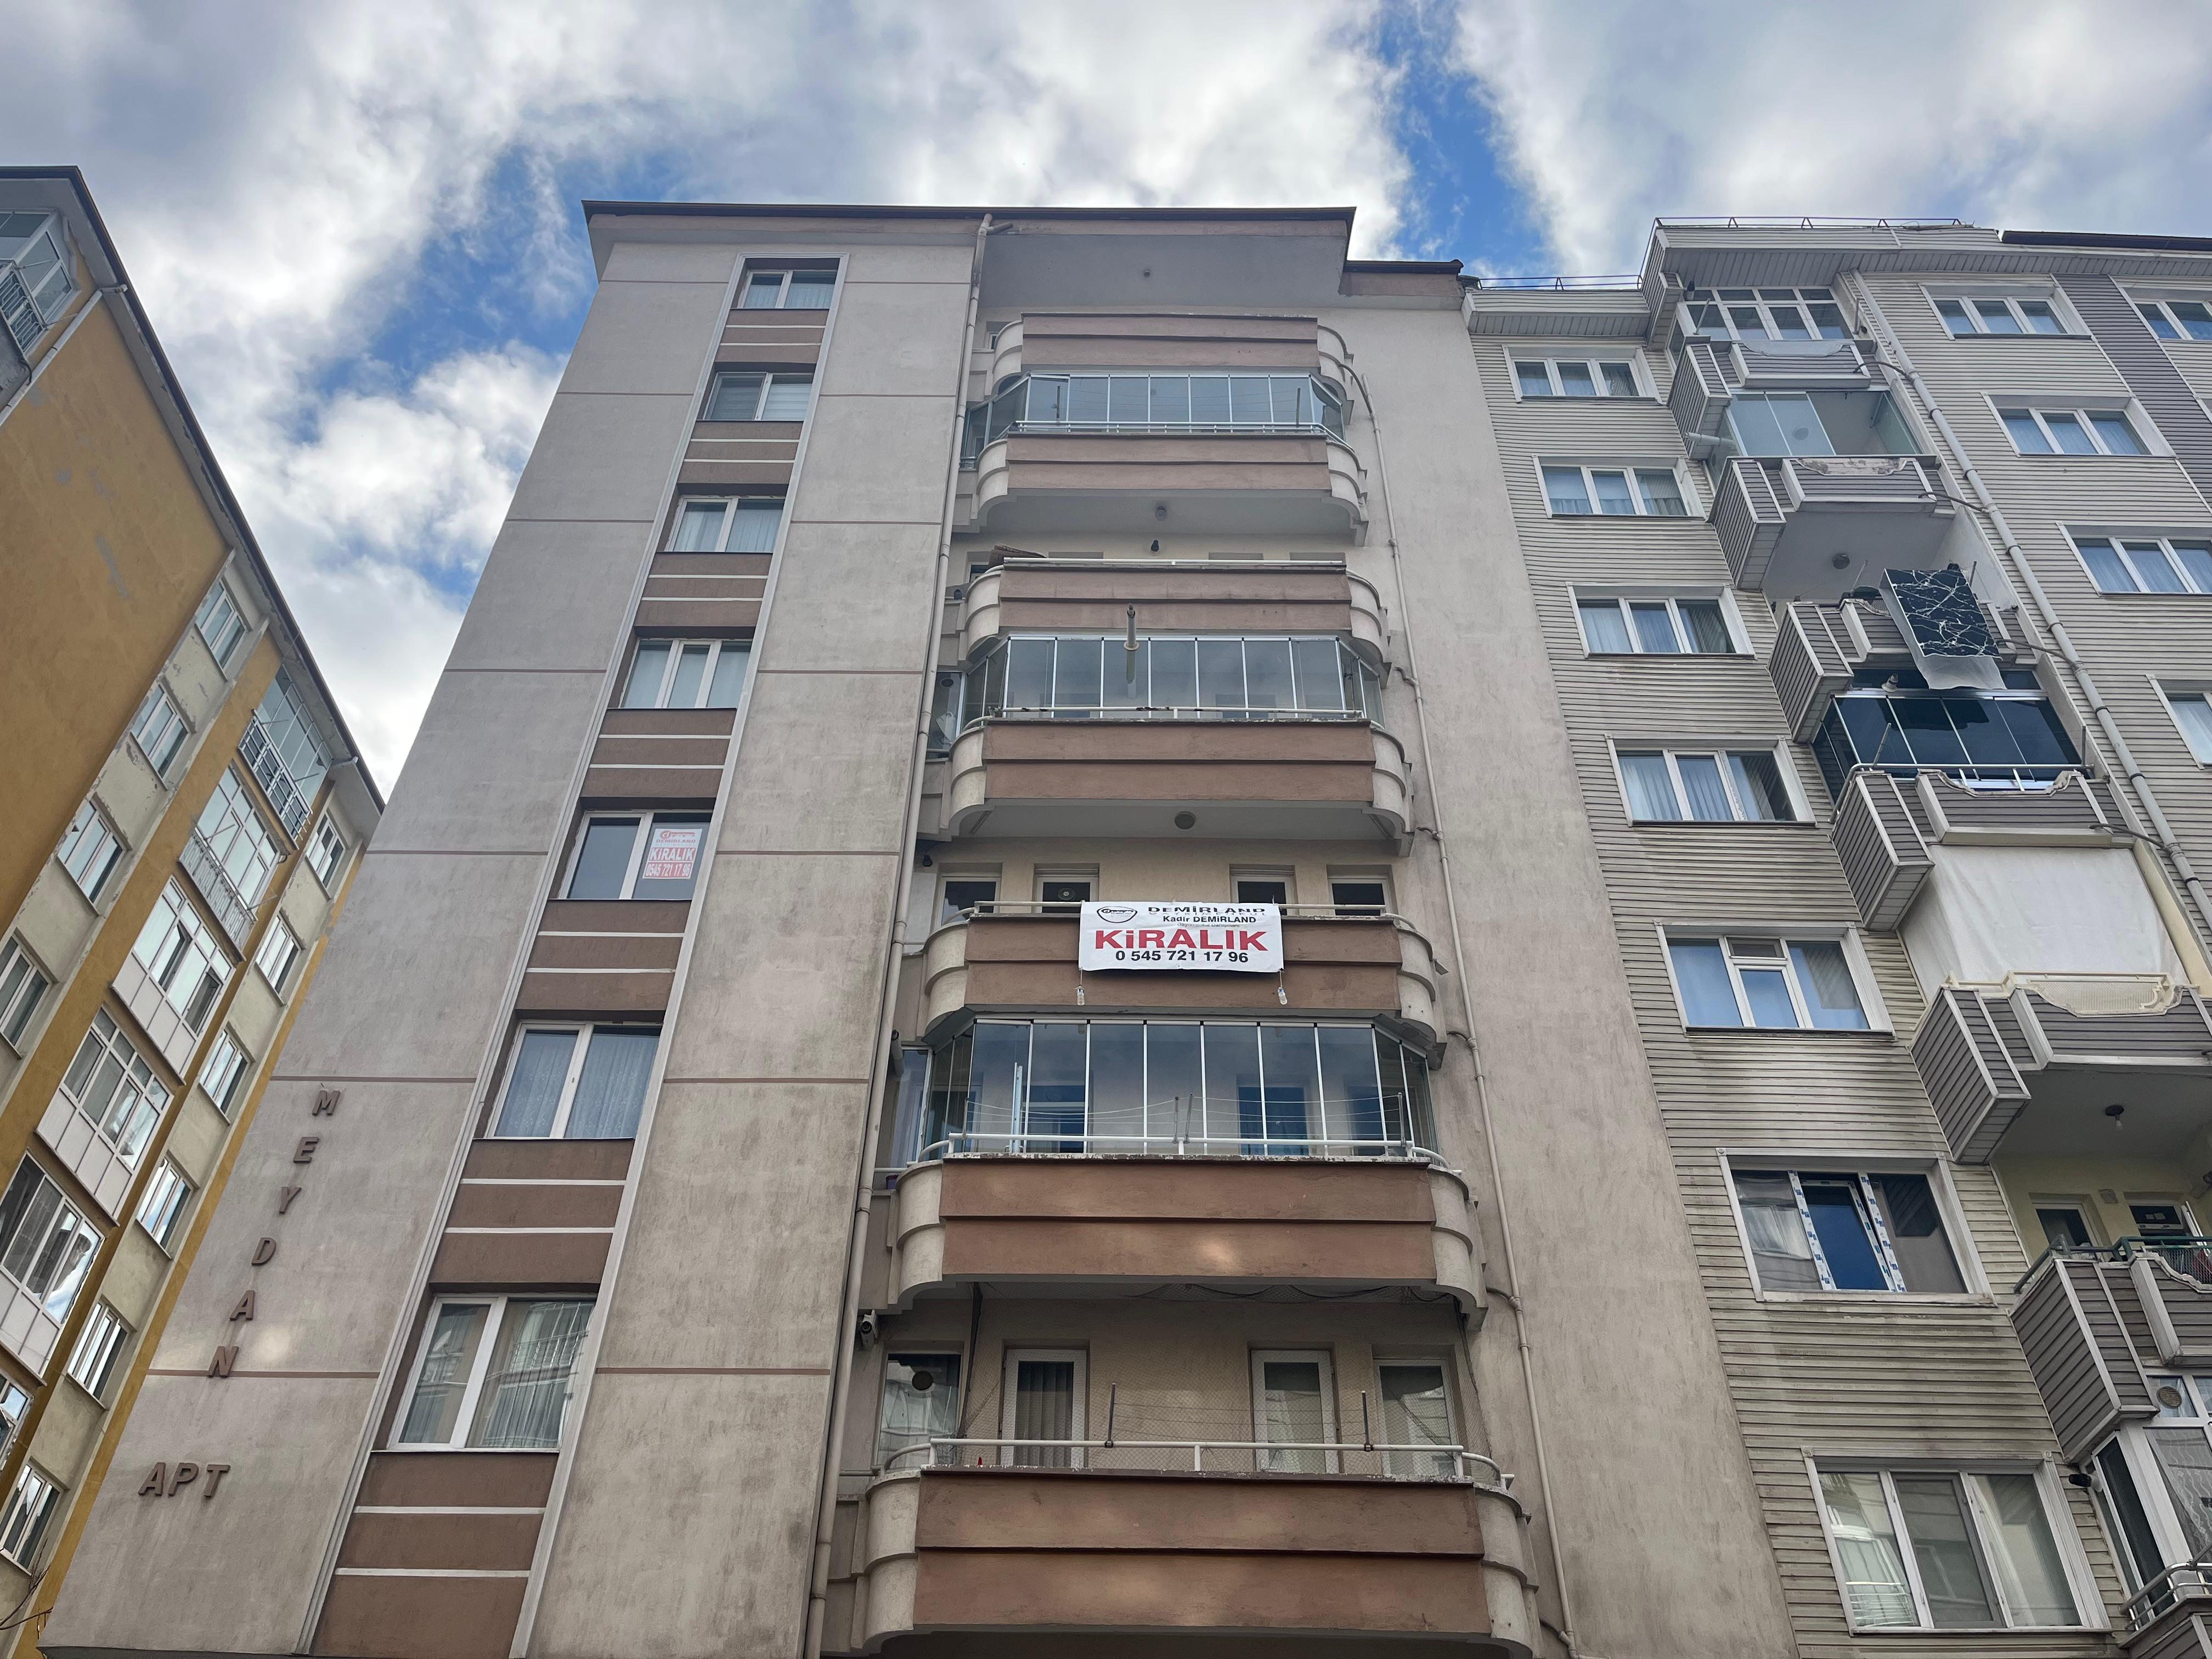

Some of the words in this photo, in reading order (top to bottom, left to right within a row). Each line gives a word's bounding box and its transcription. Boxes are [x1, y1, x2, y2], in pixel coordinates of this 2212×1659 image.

[646, 864, 662, 877] 0545
[661, 864, 674, 877] 721
[674, 864, 682, 877] 17
[1115, 951, 1125, 961] 0
[1131, 951, 1161, 961] 545
[1166, 950, 1195, 961] 721
[1204, 952, 1222, 961] 17
[1228, 952, 1249, 963] 96
[138, 1462, 230, 1498] APT
